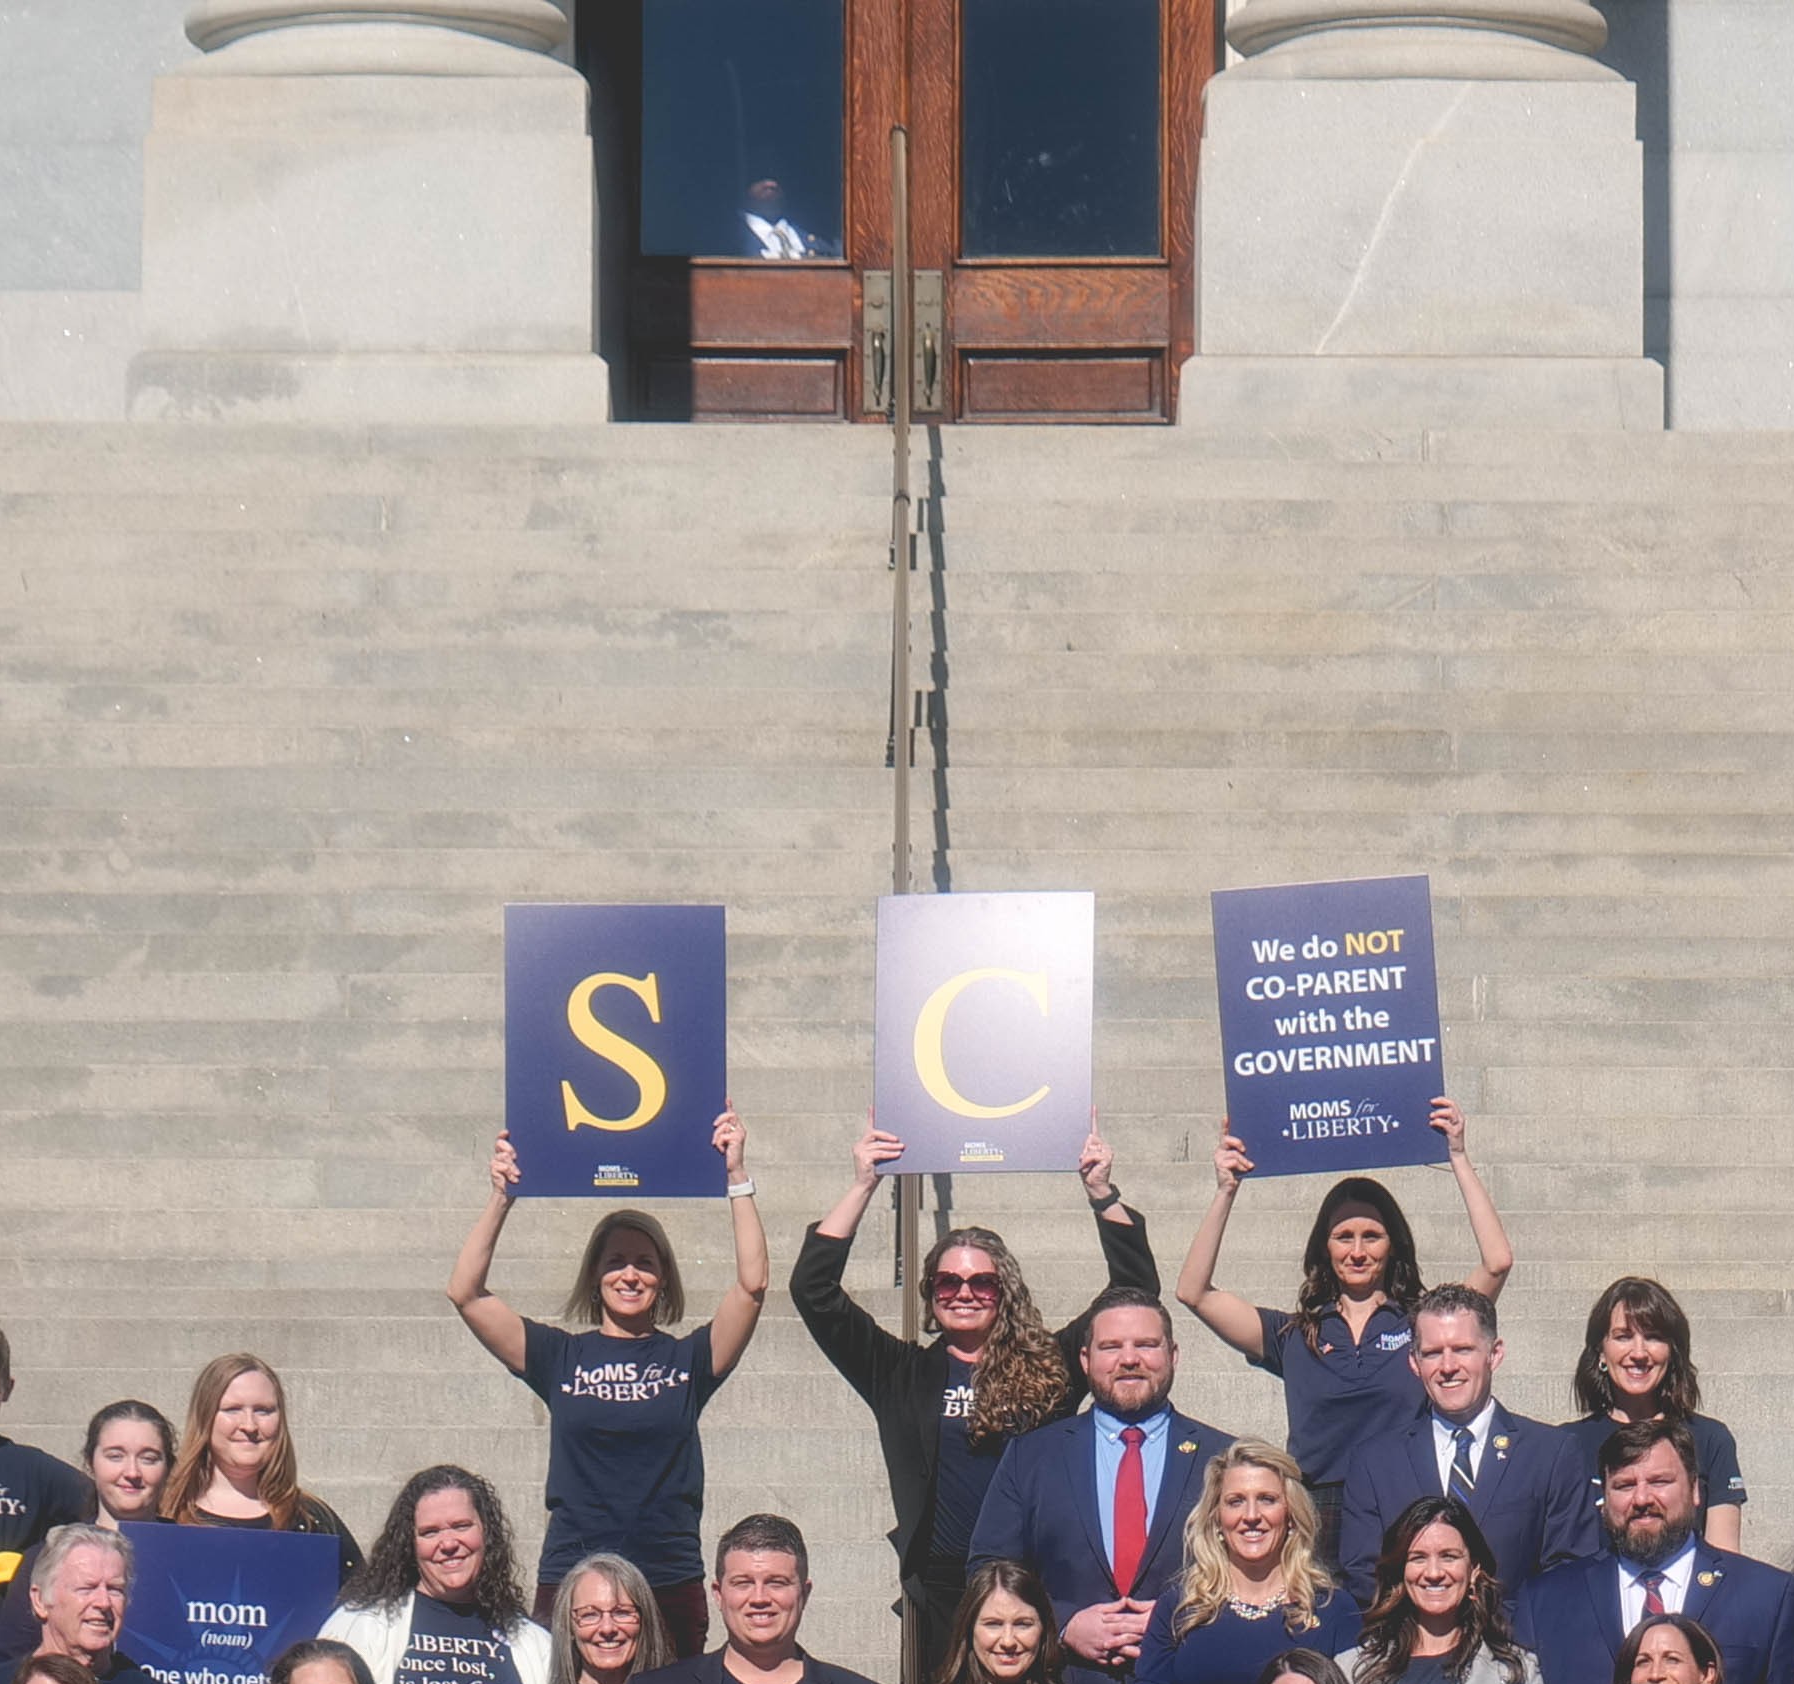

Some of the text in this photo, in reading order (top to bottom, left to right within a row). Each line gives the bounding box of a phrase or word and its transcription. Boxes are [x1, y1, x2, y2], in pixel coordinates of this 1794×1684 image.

[1252, 929, 1404, 963] We do NOT
[1246, 966, 1406, 1000] CO-PARENT
[1275, 1006, 1390, 1035] with the
[561, 972, 667, 1132] S
[914, 967, 1051, 1119] C
[1235, 1038, 1436, 1076] GOVERNMENT
[1290, 1098, 1380, 1120] MOMS for
[1291, 1115, 1394, 1140] LIBERTY
[573, 1368, 678, 1402] LIBERTY
[187, 1601, 268, 1627] mom
[201, 1629, 253, 1649] (noun)
[408, 1633, 505, 1662] IBERTY,
[399, 1657, 495, 1680] once lost,
